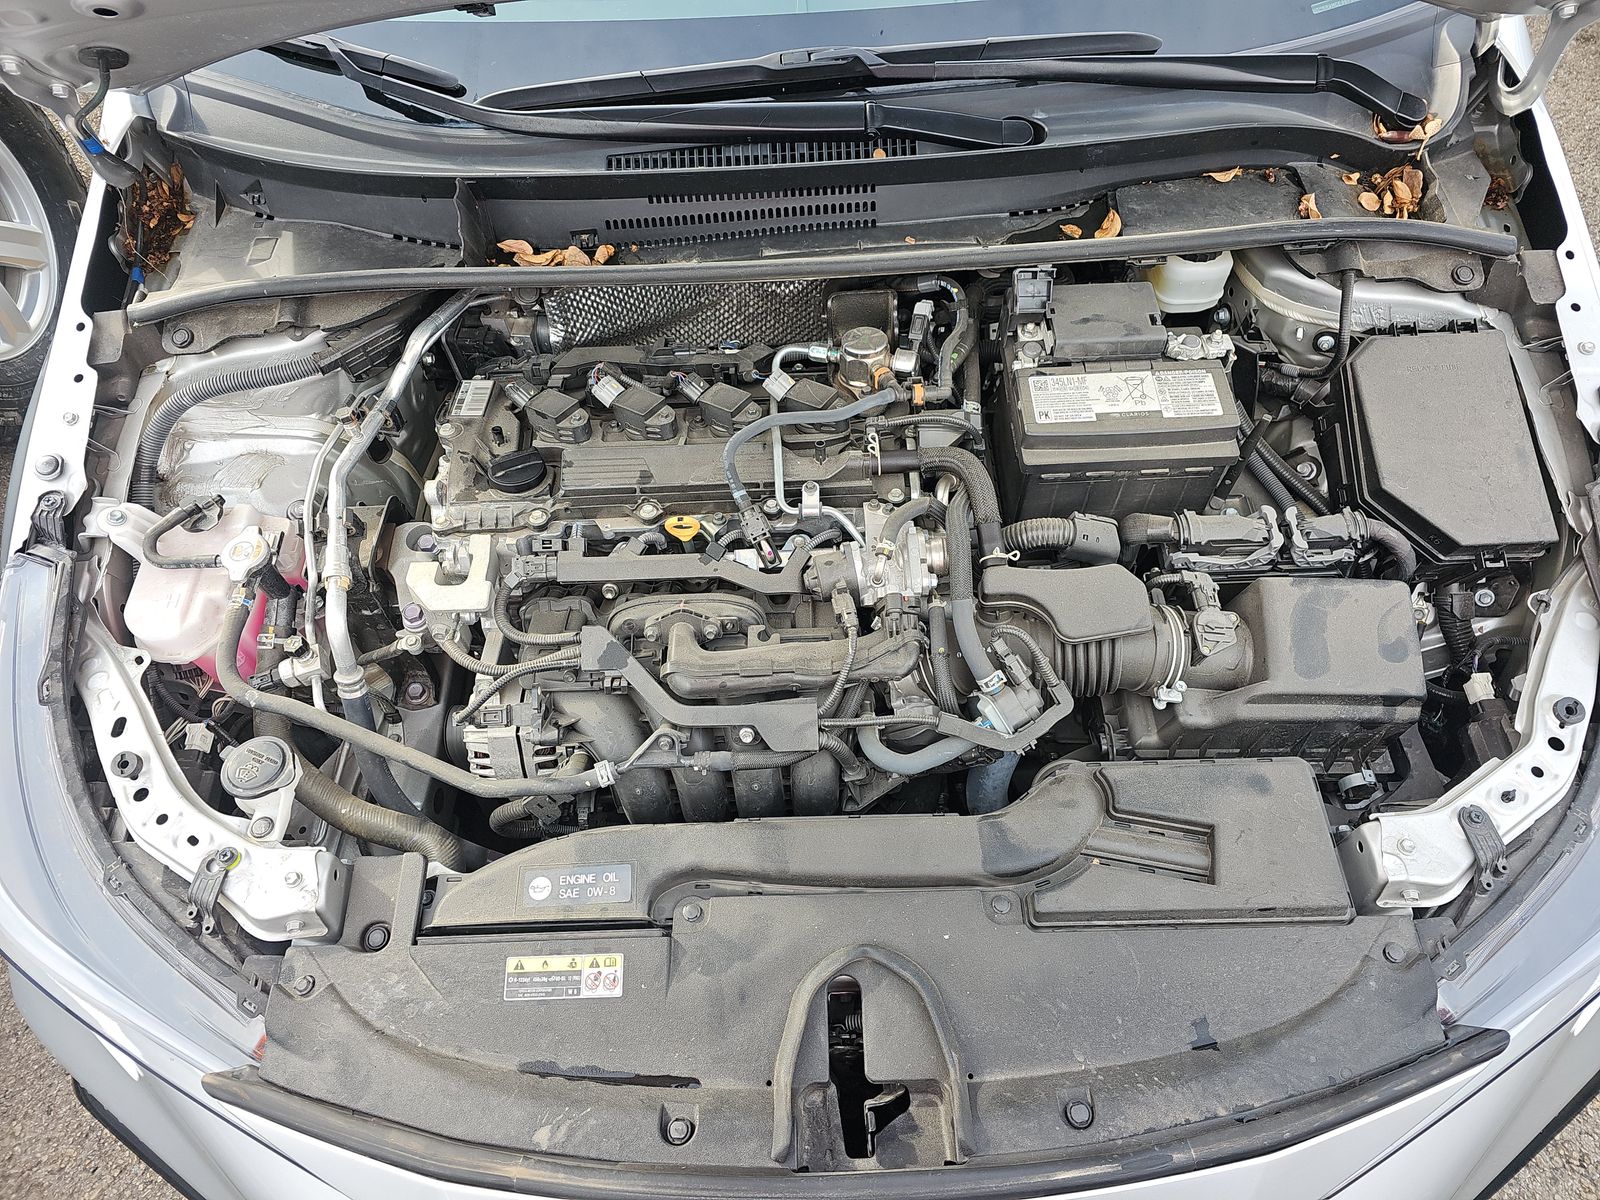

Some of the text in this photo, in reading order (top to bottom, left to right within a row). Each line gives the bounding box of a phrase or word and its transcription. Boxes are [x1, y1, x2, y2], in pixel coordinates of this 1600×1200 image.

[1038, 410, 1051, 420] PK
[560, 872, 619, 886] ENGINE OIL
[559, 886, 616, 899] SAE 0W-8
